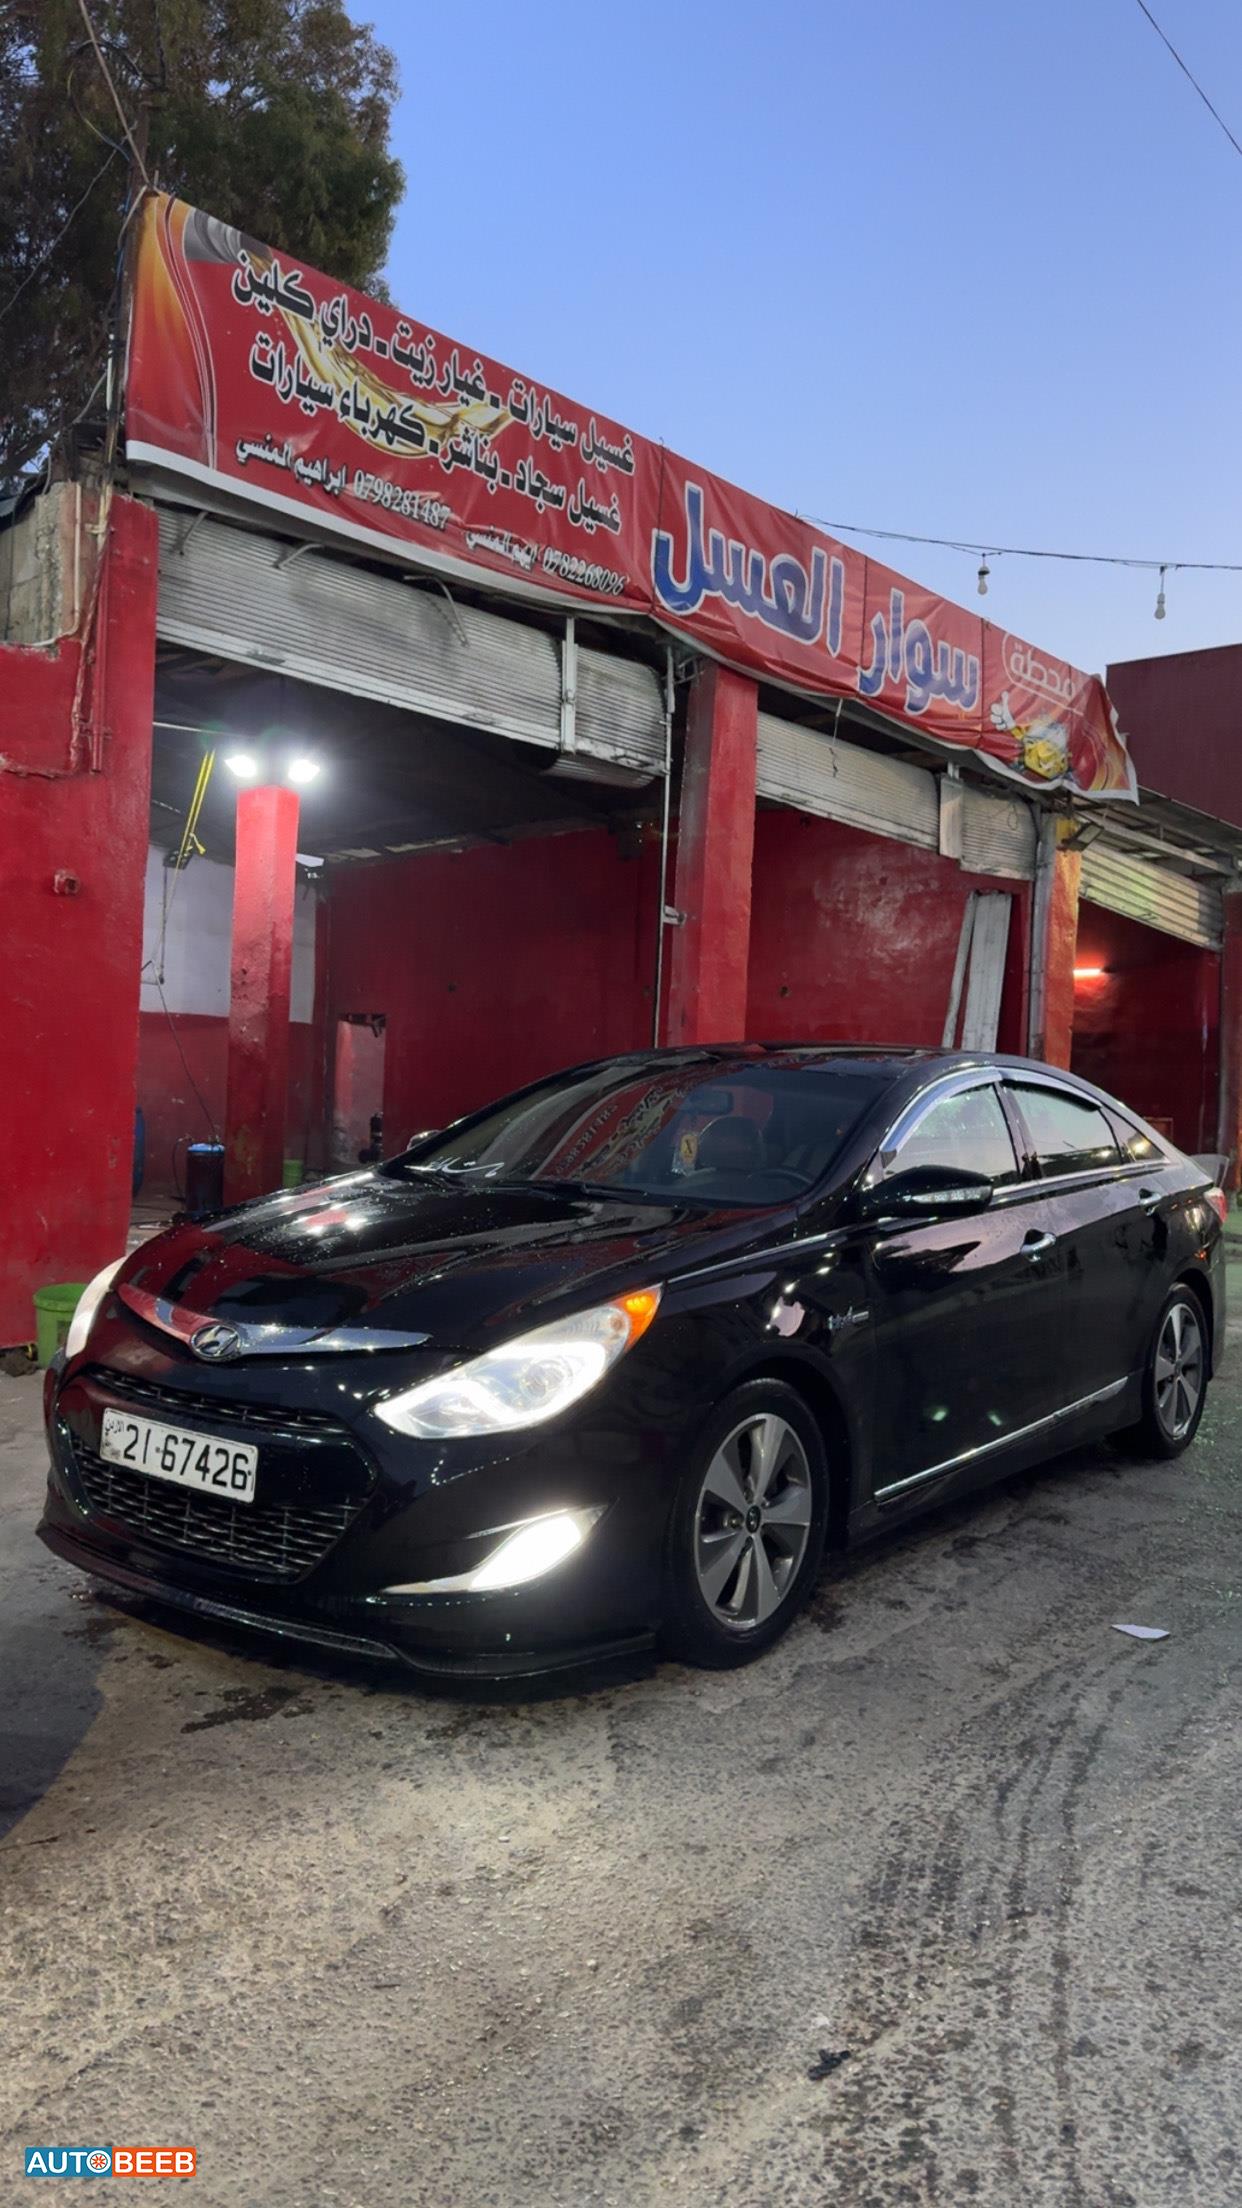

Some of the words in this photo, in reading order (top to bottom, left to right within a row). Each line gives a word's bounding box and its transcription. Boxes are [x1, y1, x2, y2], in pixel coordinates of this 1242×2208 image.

[231, 249, 315, 322] كلين
[249, 331, 335, 417] سيارات
[436, 349, 487, 407] غيار
[508, 378, 577, 448] سيارات
[235, 432, 292, 468] المنسي
[581, 417, 635, 475] غسيل
[353, 470, 451, 530] 0798281487
[568, 477, 622, 535] غسيل
[541, 546, 627, 596] 0782268096
[651, 481, 844, 658] العسل
[855, 587, 980, 716] سوار
[1010, 642, 1076, 702] محطة
